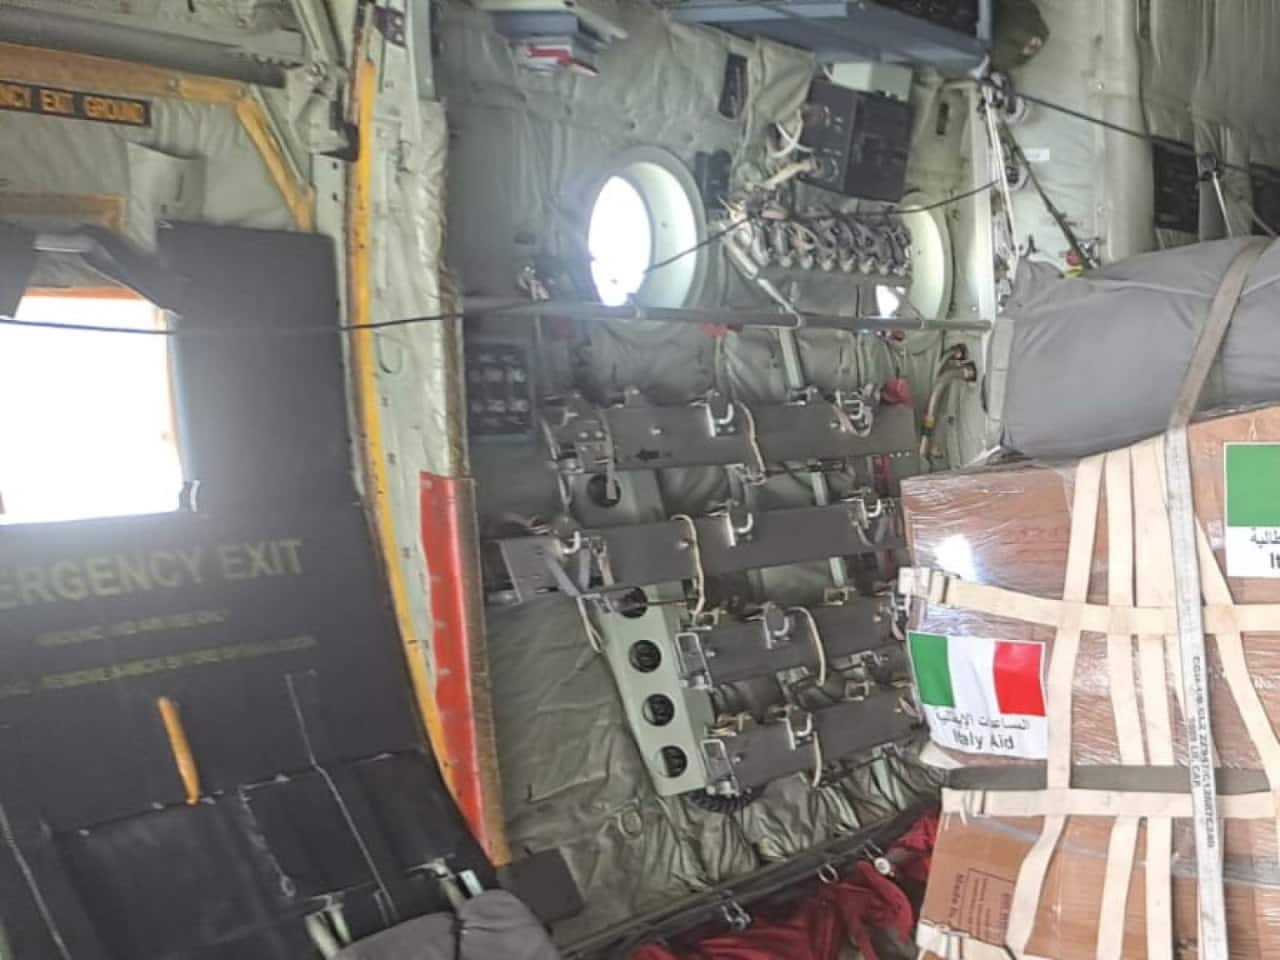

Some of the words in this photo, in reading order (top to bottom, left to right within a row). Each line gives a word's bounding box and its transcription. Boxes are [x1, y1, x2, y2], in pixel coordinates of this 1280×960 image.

[221, 538, 303, 583] EXIT
[952, 728, 984, 750] Italy
[989, 734, 1015, 750] Aid
